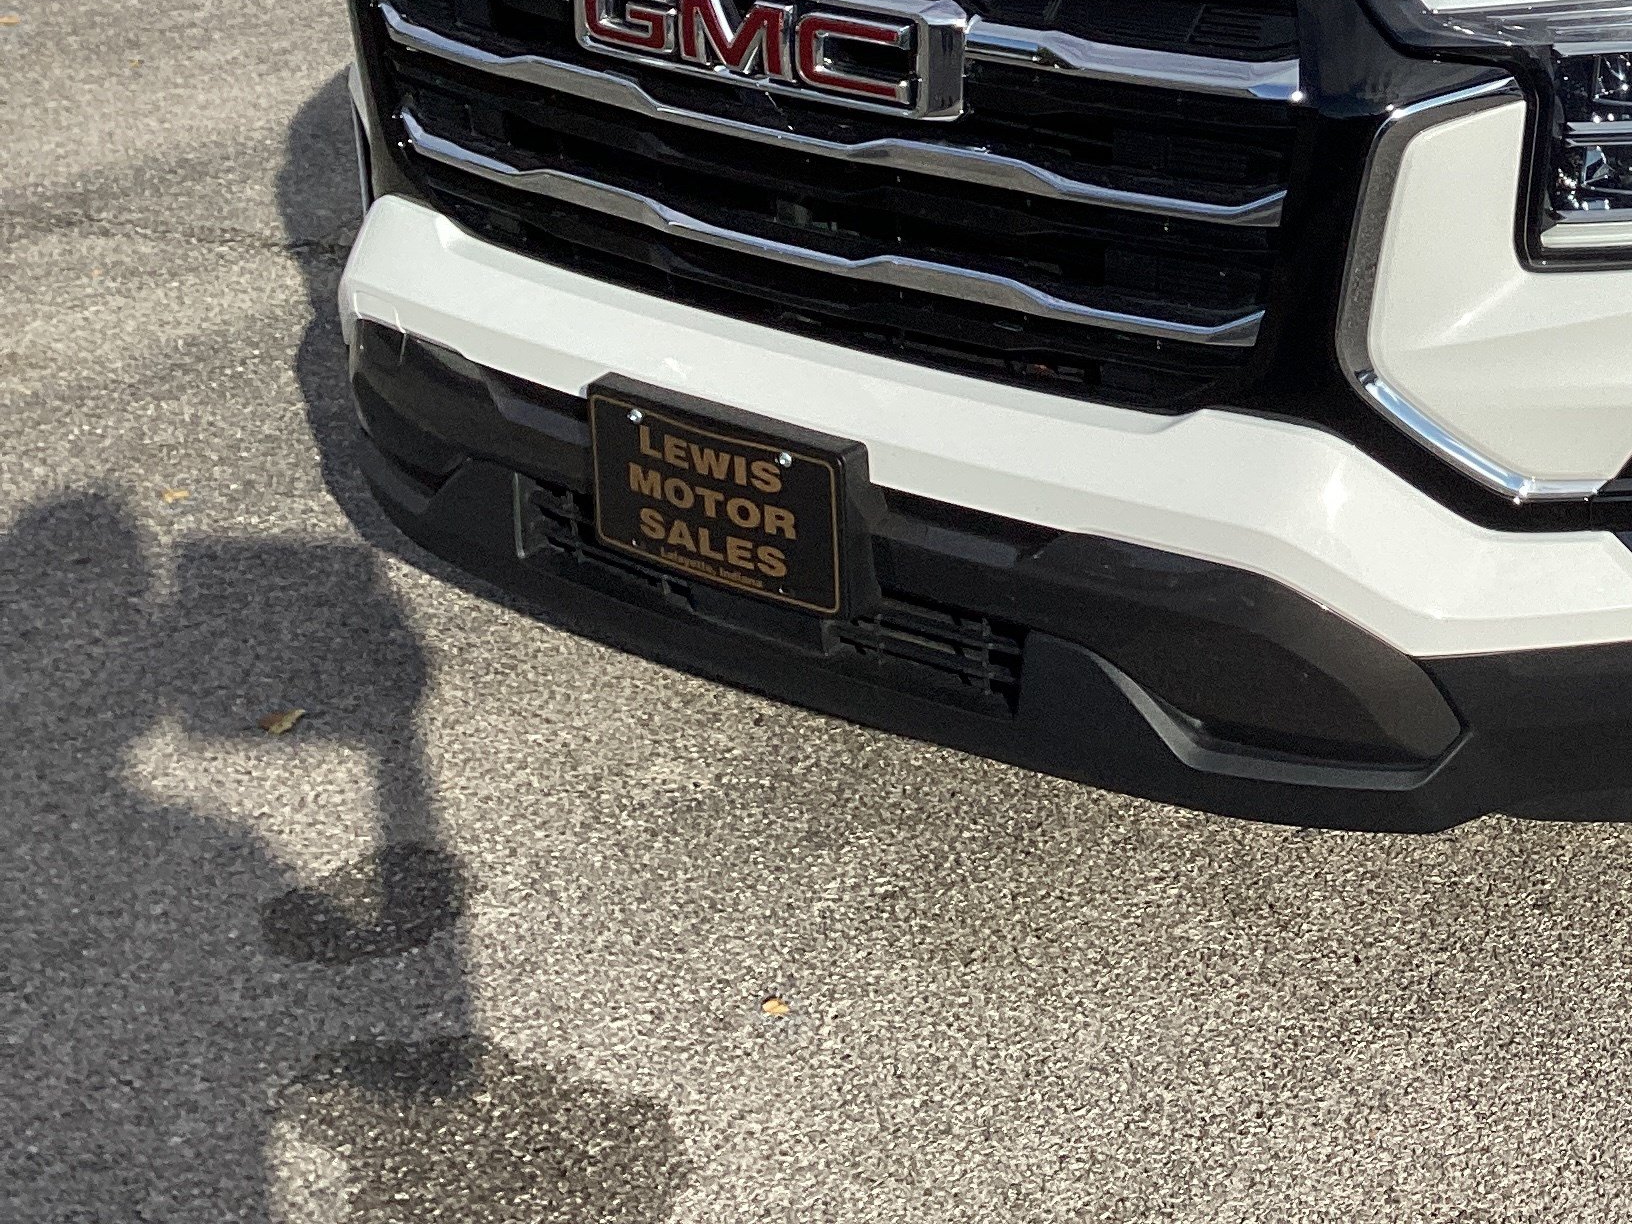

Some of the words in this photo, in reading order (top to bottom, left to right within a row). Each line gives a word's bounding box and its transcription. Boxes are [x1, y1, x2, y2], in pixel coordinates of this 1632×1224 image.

[637, 424, 783, 494] LEWIS
[628, 462, 797, 540] MOTOR
[640, 507, 788, 578] SALES
